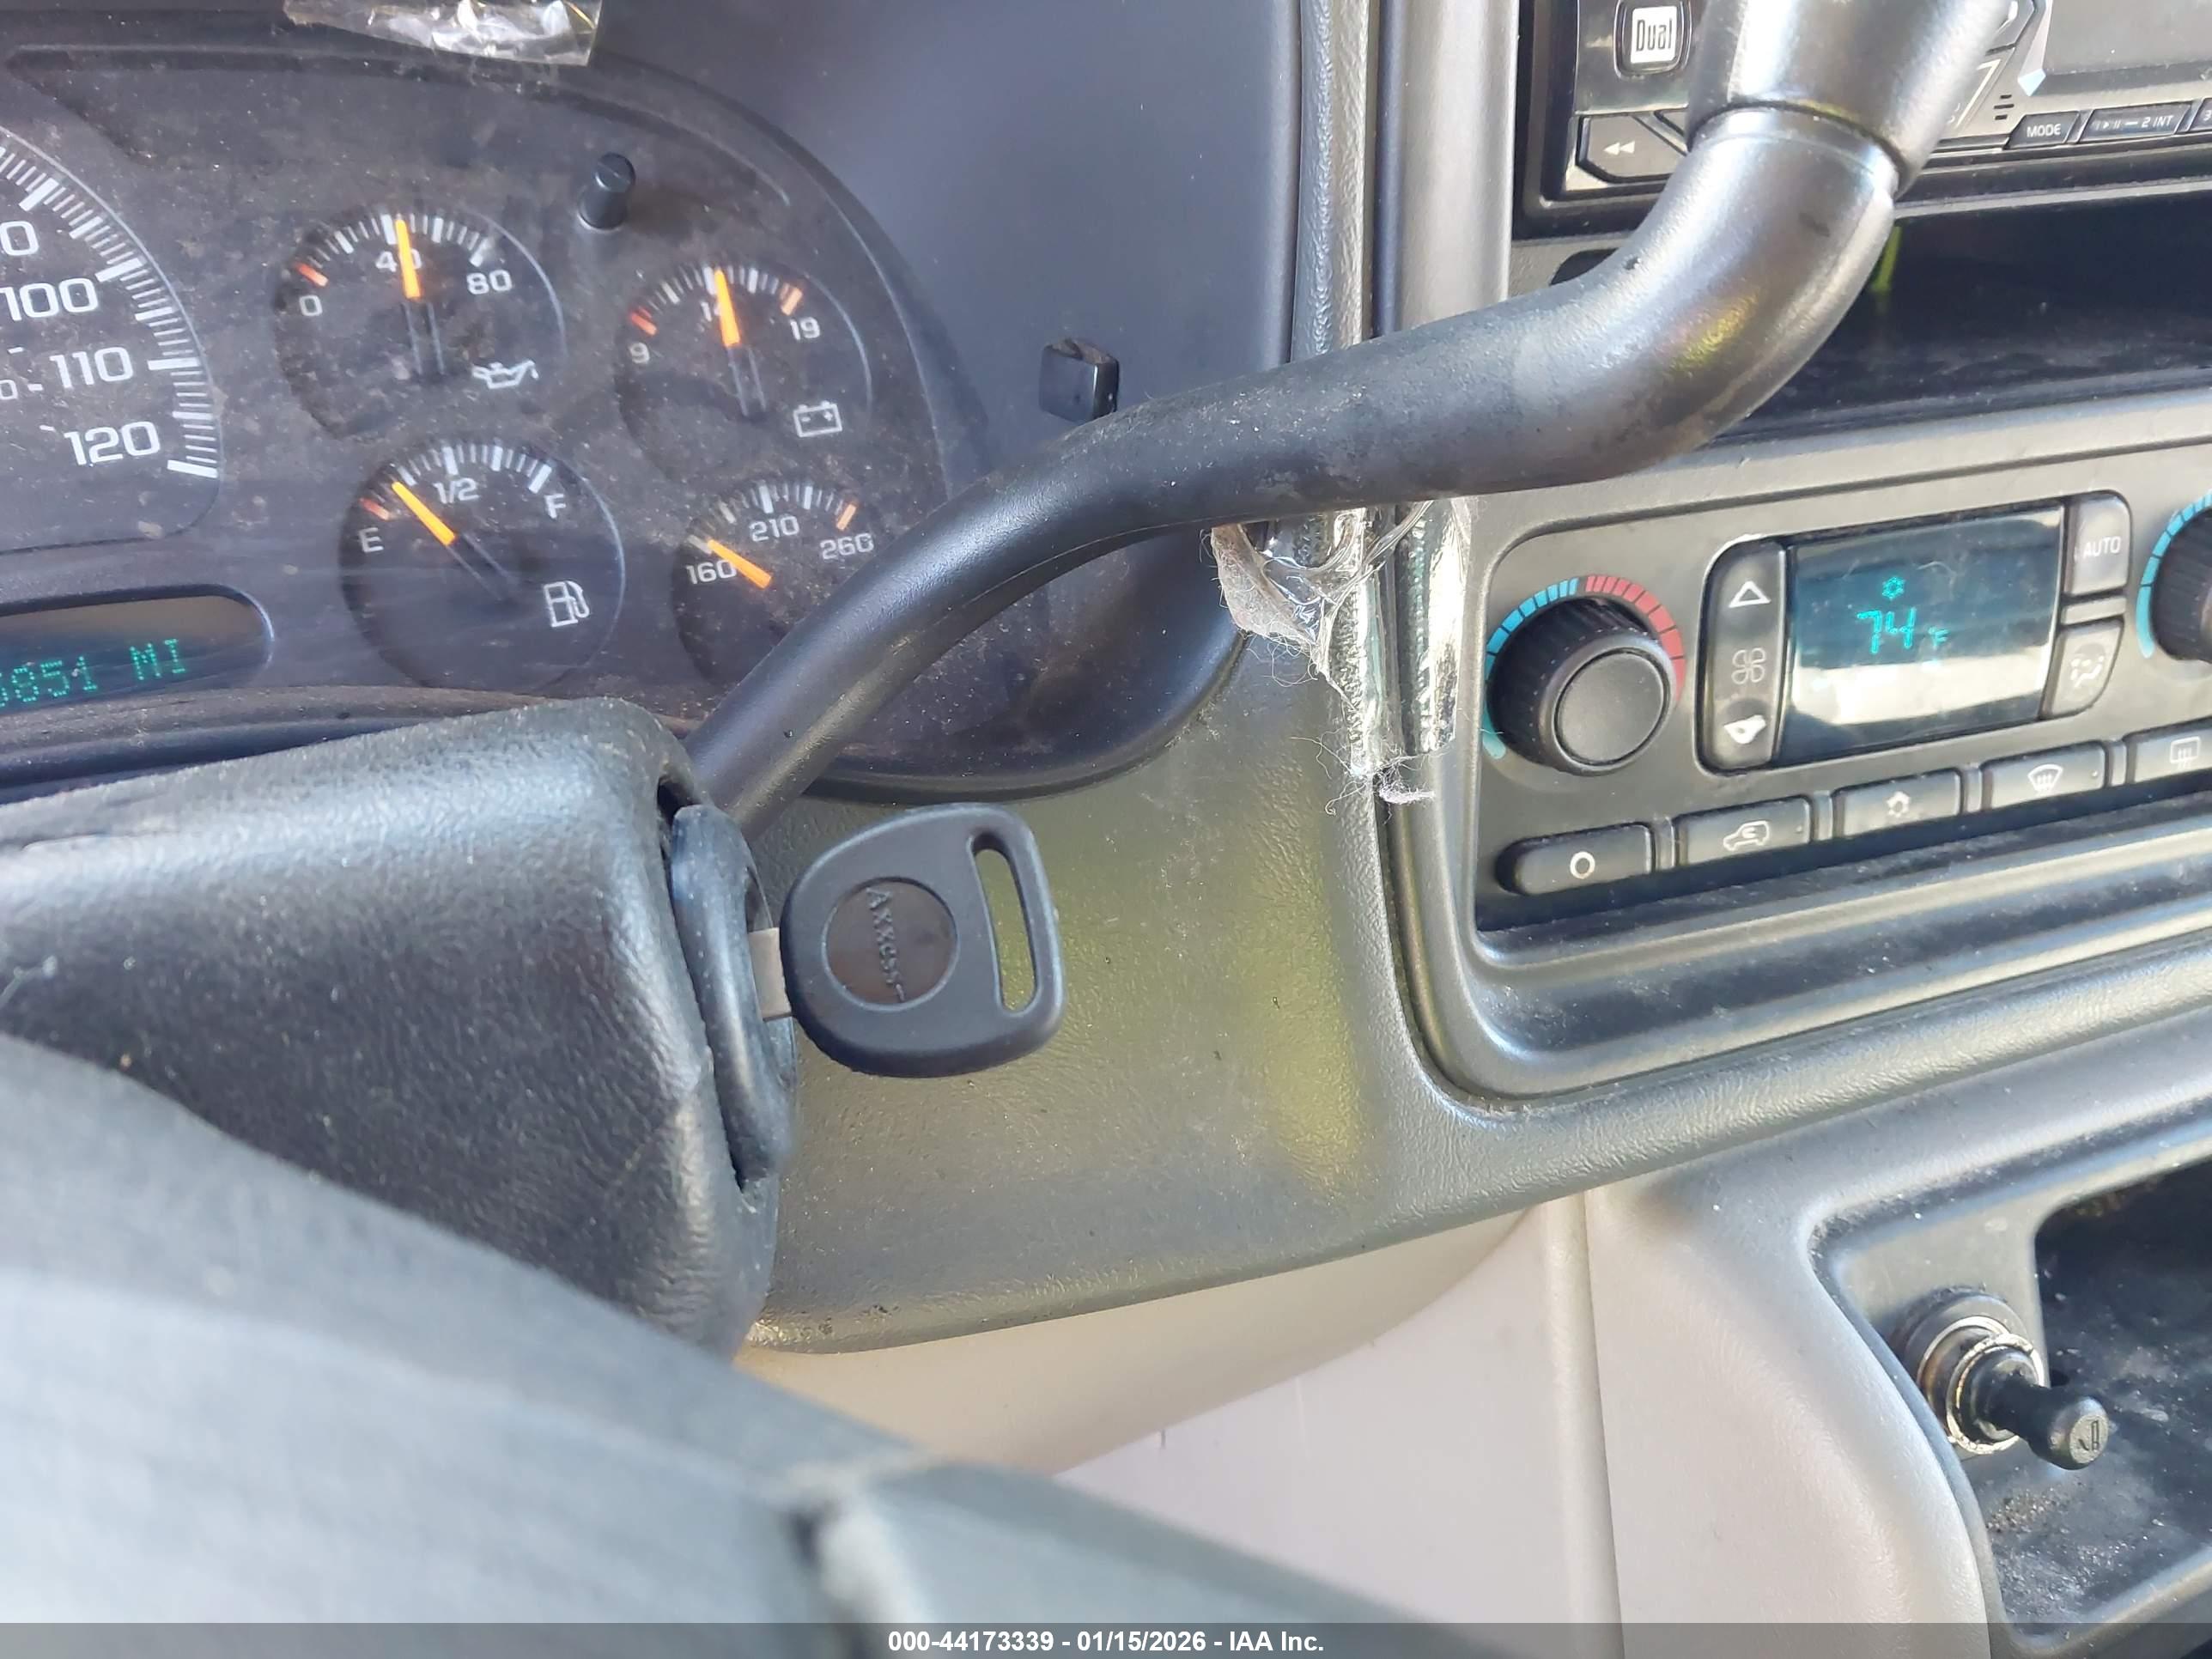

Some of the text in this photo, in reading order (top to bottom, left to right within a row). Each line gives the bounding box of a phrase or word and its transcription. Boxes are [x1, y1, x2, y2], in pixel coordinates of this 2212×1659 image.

[1636, 17, 1673, 52] Dual
[2027, 123, 2061, 138] MODE
[466, 269, 513, 295] 80
[0, 277, 99, 321] 100
[299, 295, 323, 317] 0
[789, 317, 821, 341] 19
[629, 342, 650, 364] 9
[49, 346, 134, 390] 110
[64, 421, 161, 465] 120
[434, 477, 479, 505] 1/2
[544, 493, 567, 519] F
[358, 527, 384, 554] E
[749, 515, 800, 543] 210
[819, 532, 875, 560] 260
[2082, 536, 2121, 560] AUTO
[686, 560, 738, 586] 160
[1856, 606, 1917, 653] 74
[130, 638, 186, 681] MI
